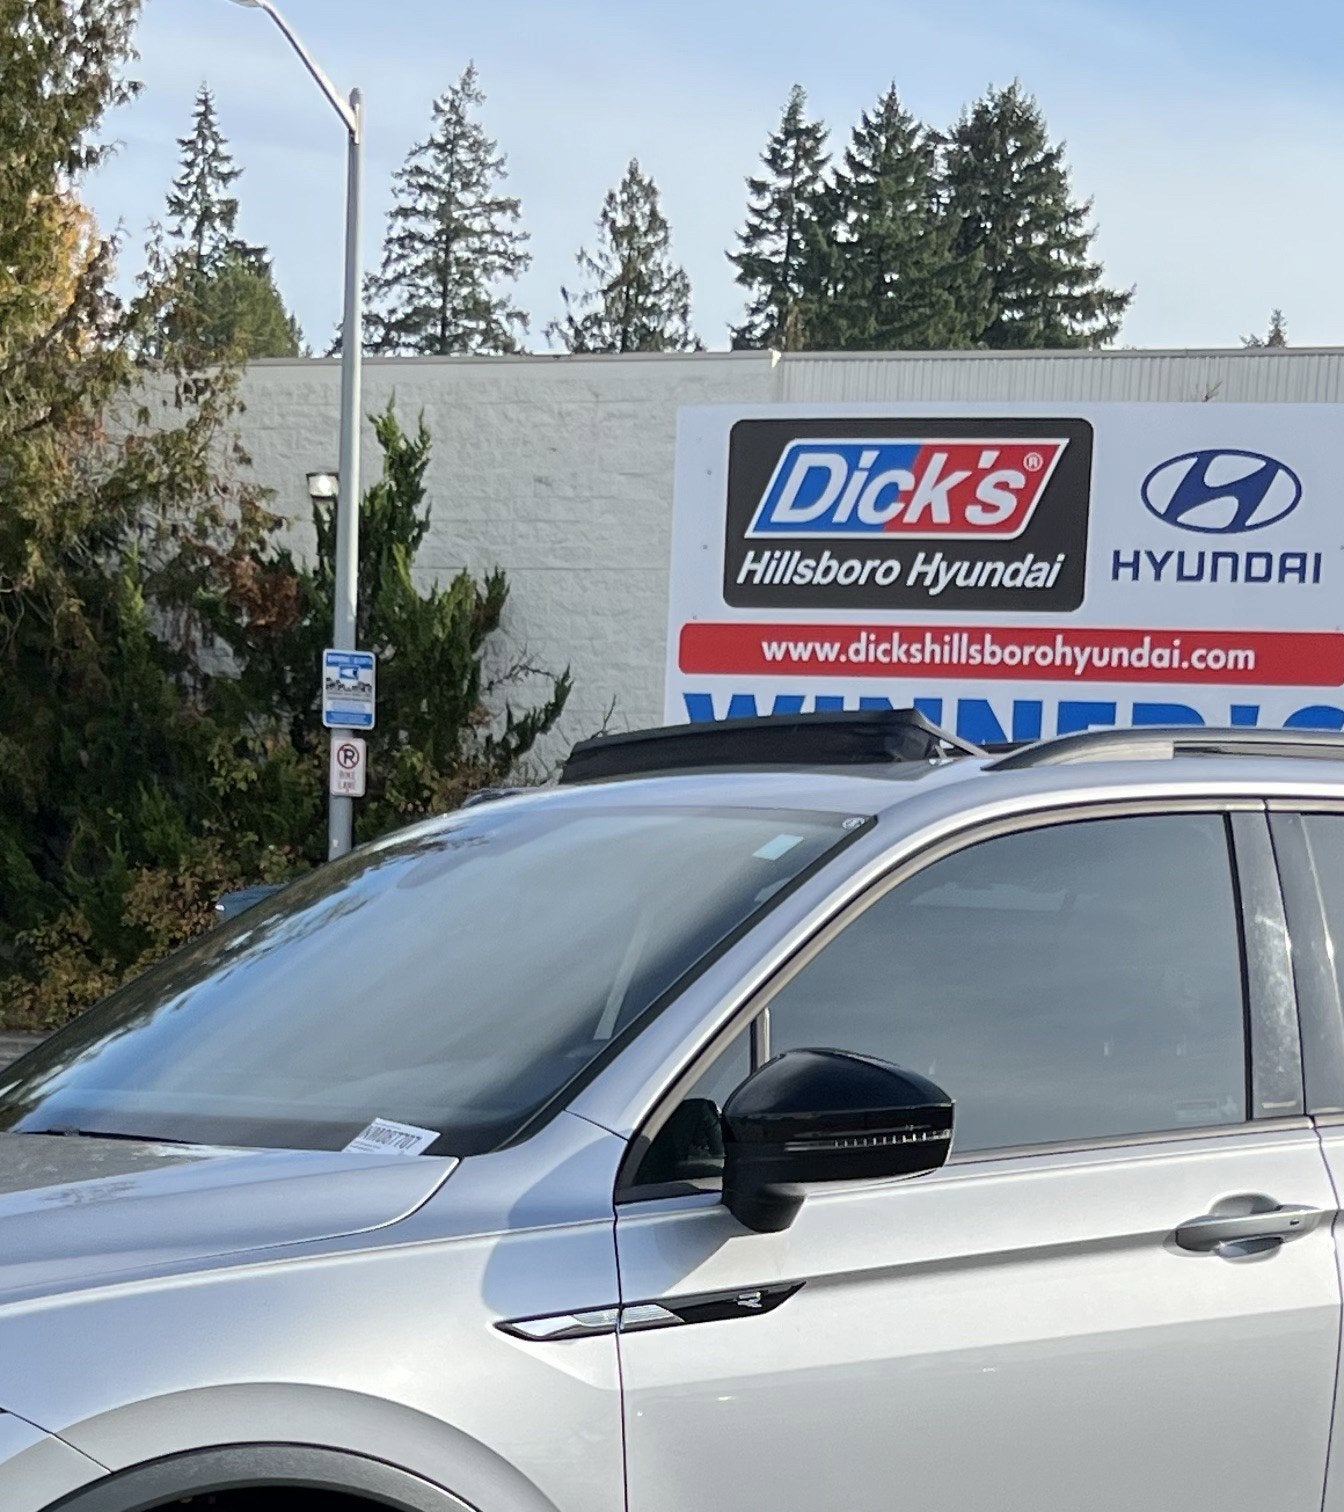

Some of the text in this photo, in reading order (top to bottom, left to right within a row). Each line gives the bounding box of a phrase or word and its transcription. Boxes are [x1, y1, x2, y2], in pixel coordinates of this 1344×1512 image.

[736, 550, 1067, 596] Hillsboro Hyundai
[1111, 549, 1323, 585] HYUNDAI
[762, 630, 1257, 675] www.dickshillsborohyundai.com
